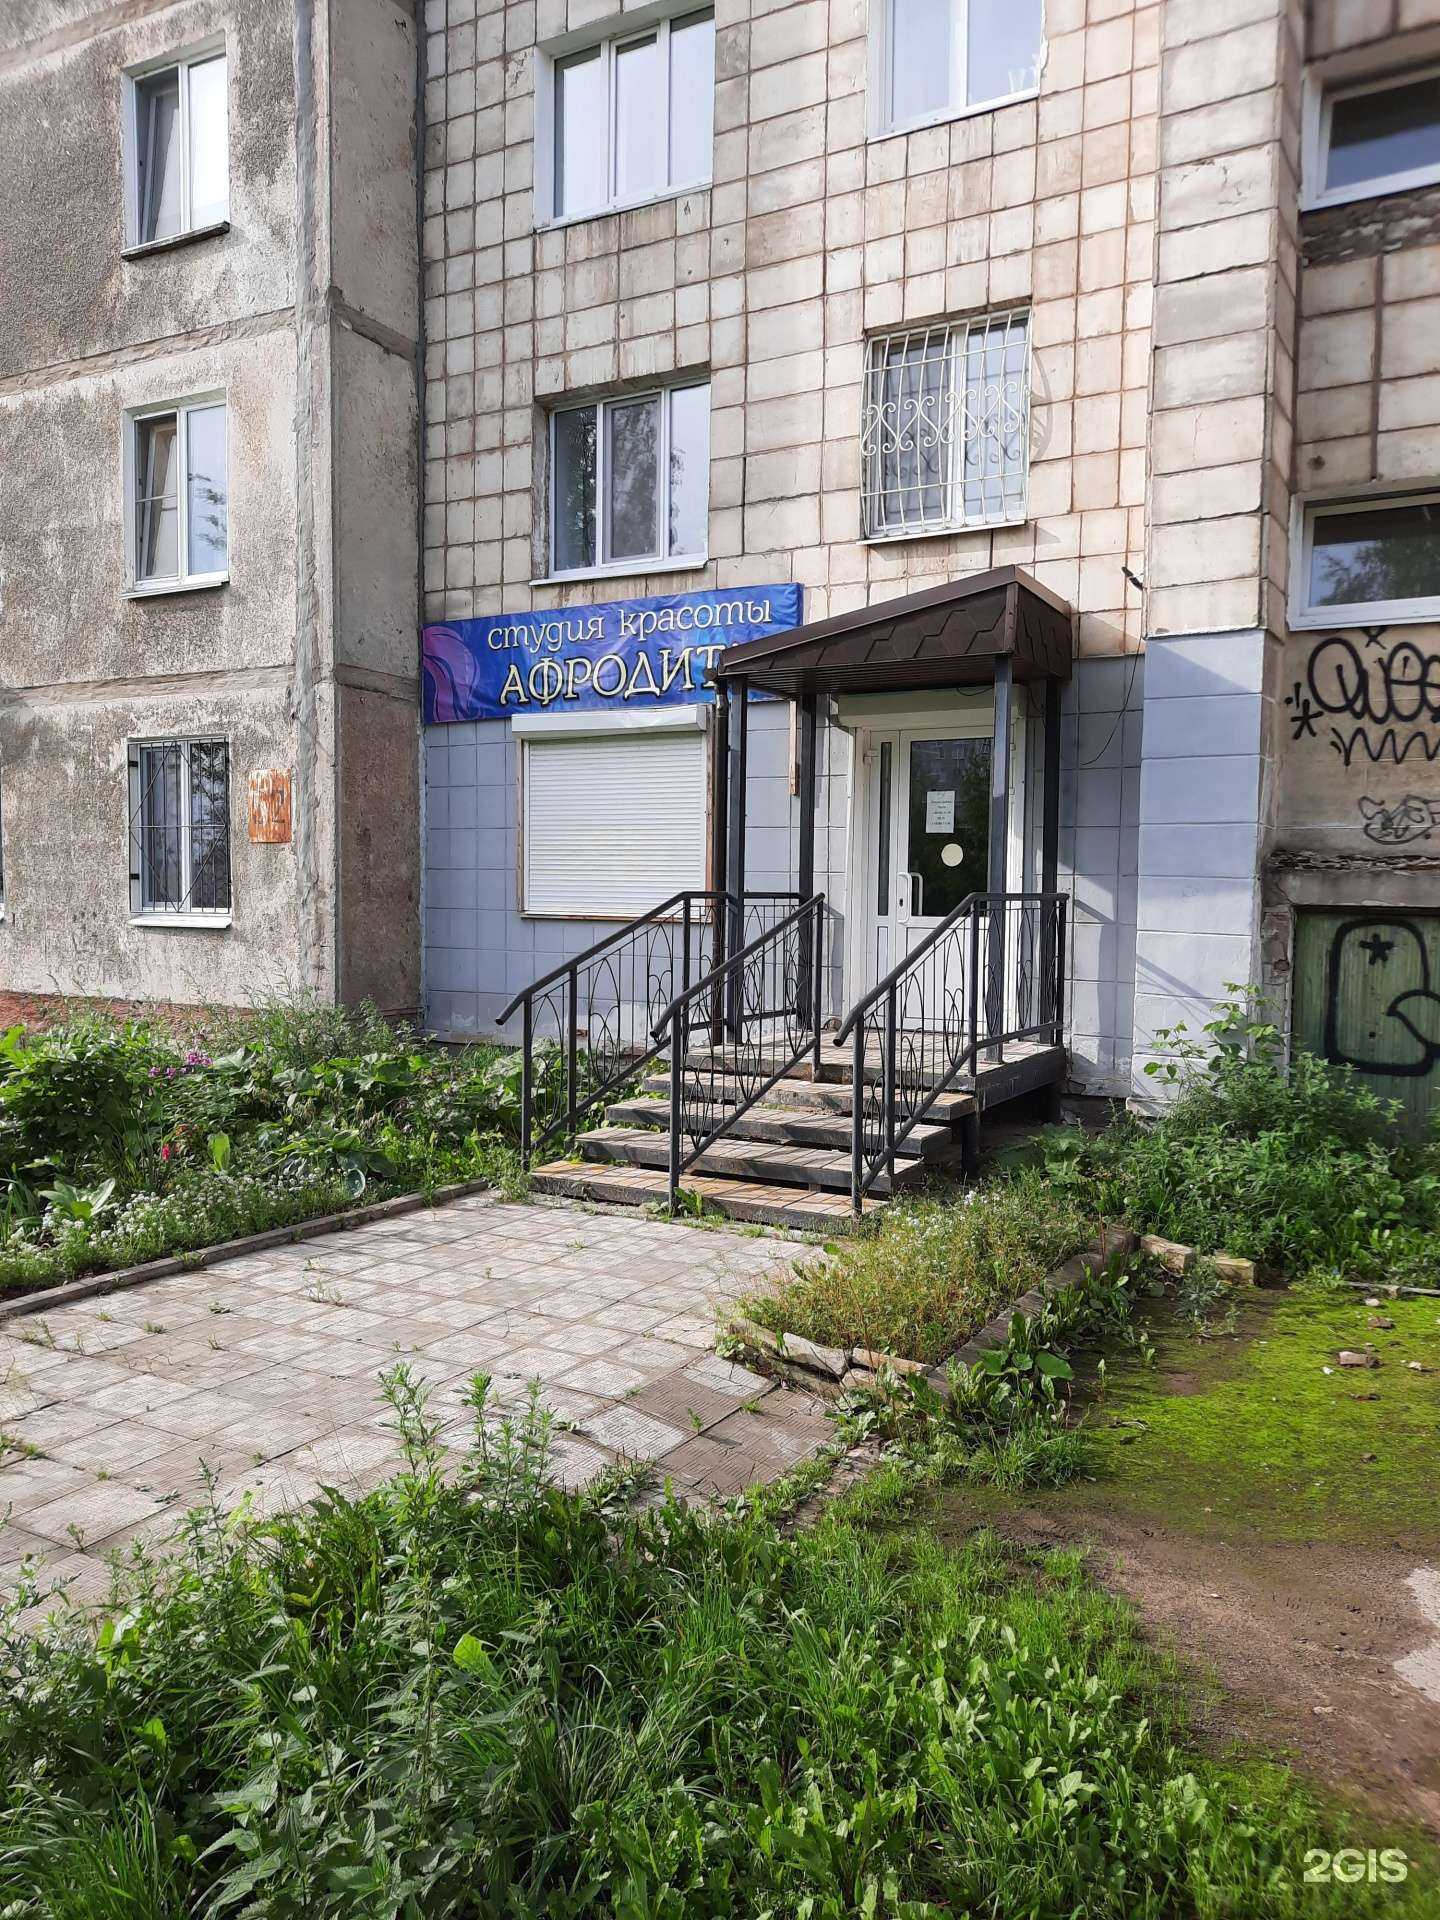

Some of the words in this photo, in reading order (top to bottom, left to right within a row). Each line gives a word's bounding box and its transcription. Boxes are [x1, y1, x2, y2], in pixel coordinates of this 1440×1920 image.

[487, 616, 605, 653] студия
[619, 600, 773, 642] красоты
[500, 643, 740, 705] АФРОДИТ
